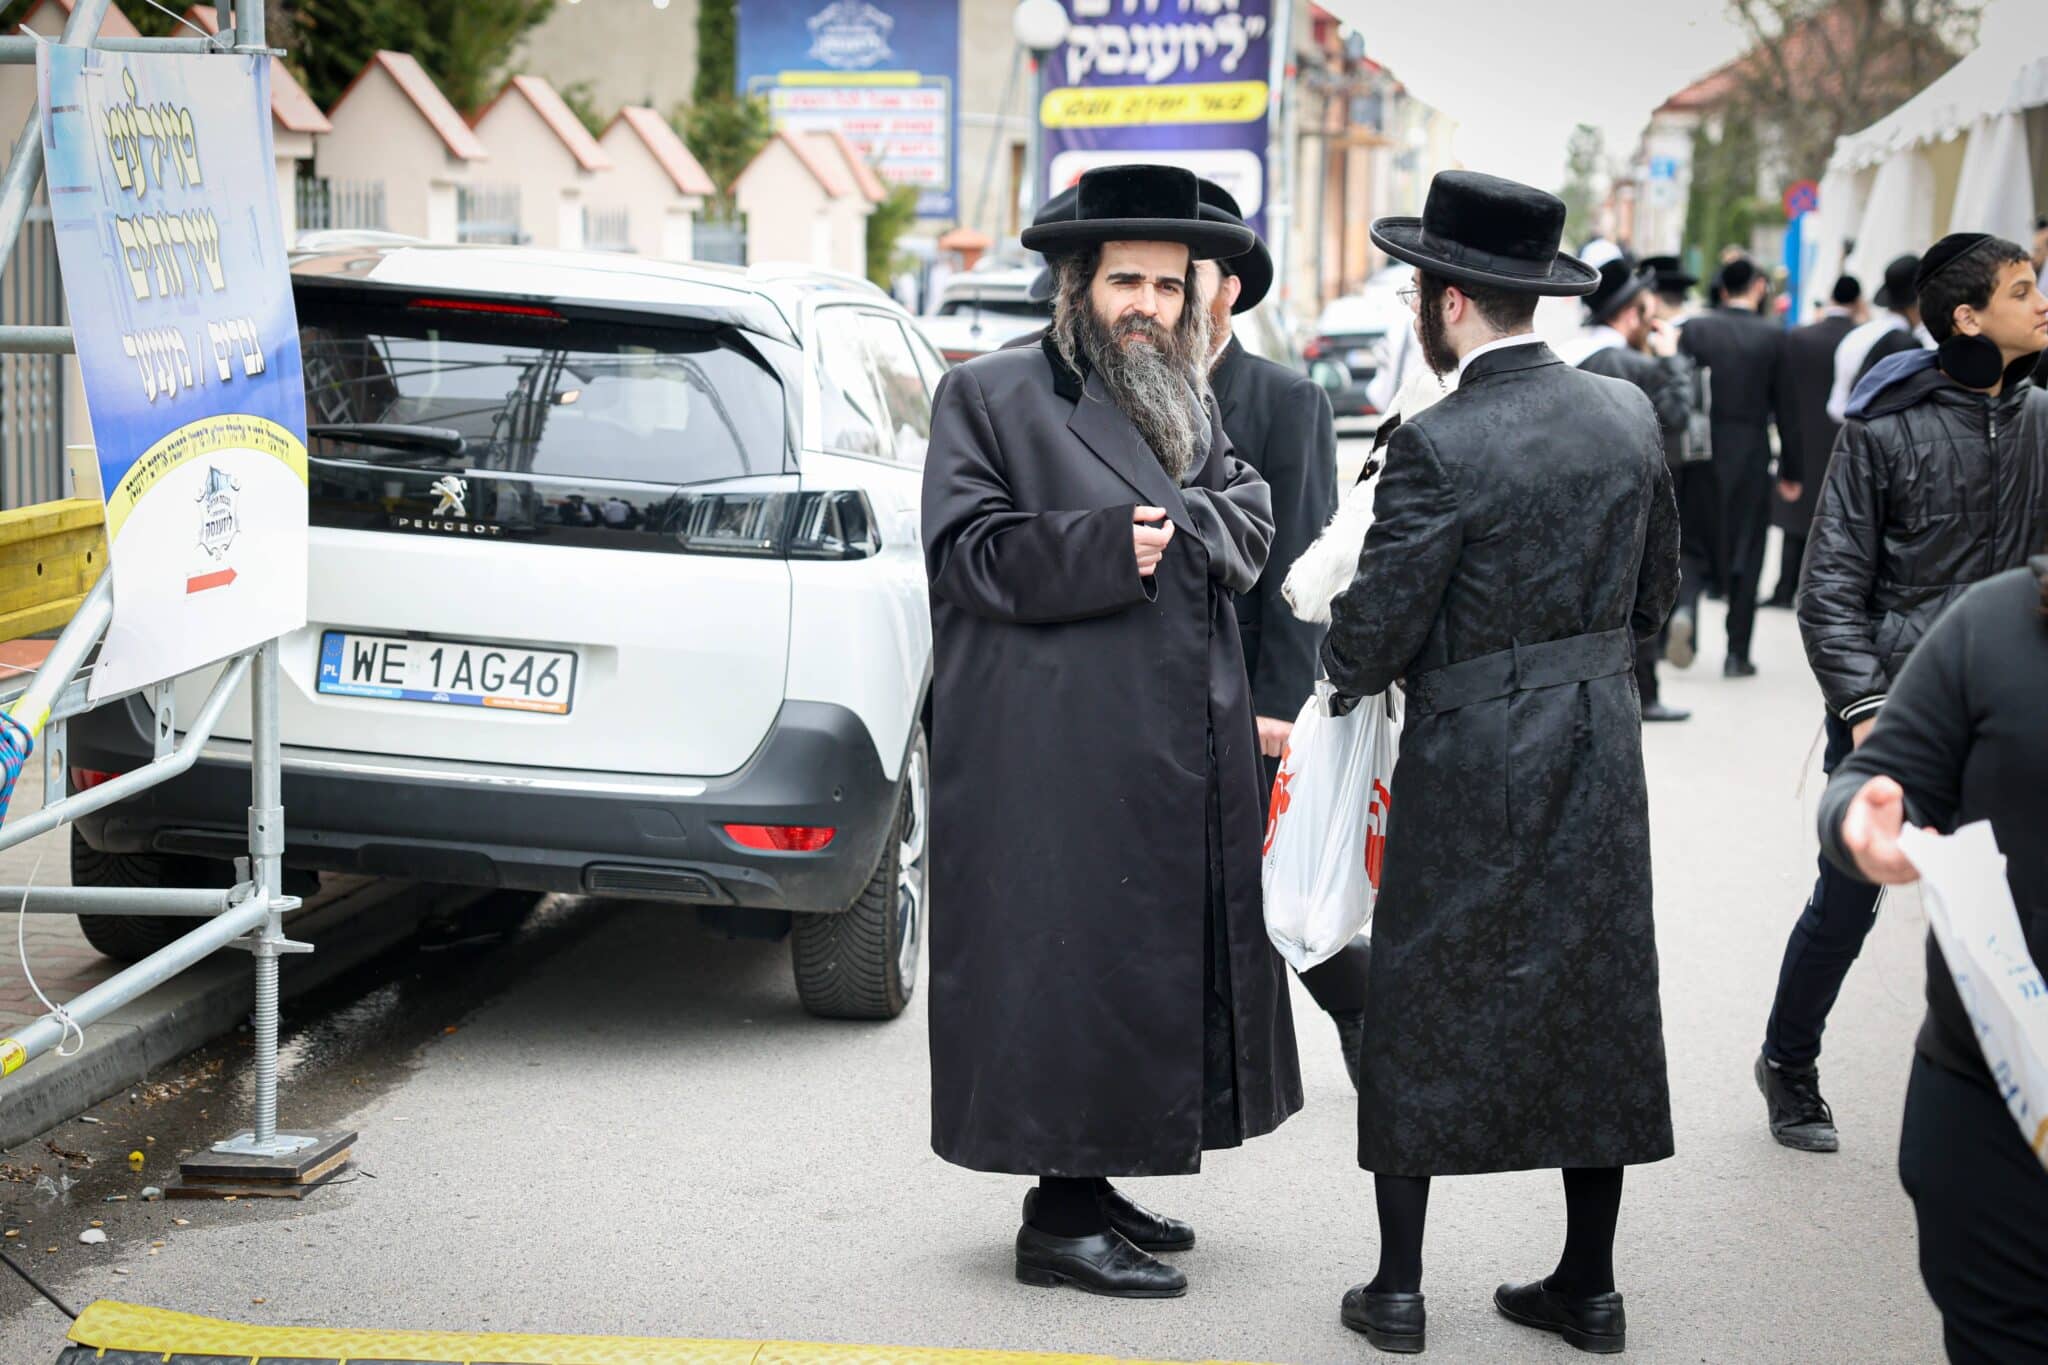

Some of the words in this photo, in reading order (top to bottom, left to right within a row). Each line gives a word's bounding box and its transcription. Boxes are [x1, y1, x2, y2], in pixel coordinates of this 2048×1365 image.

[116, 208, 225, 300] שירותים
[122, 326, 194, 403] מענער
[208, 316, 265, 382] גברים
[399, 517, 500, 535] PEUGEOT
[323, 664, 339, 678] PL
[352, 640, 408, 686] WE
[429, 647, 561, 698] 1AG46
